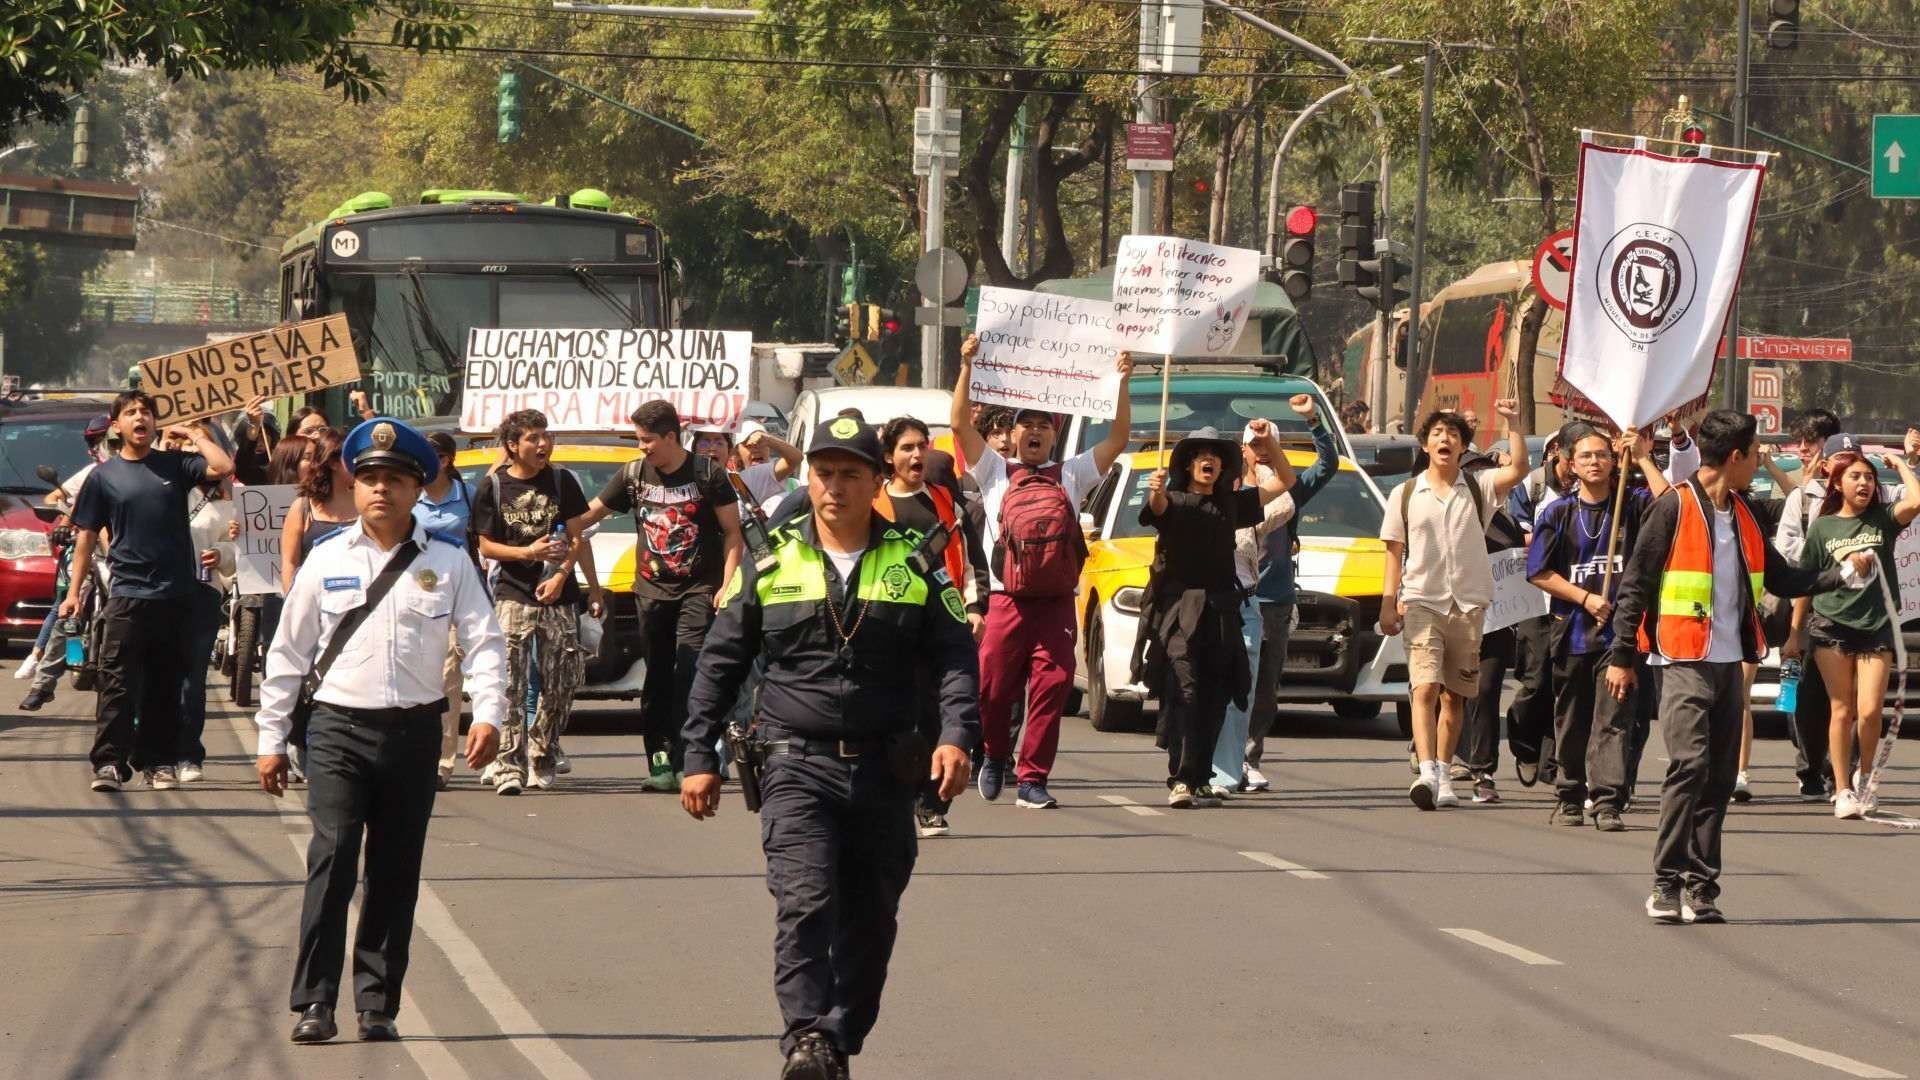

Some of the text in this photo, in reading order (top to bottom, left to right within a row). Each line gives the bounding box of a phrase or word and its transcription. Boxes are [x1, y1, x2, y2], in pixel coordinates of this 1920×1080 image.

[335, 238, 357, 250] M1
[1126, 240, 1148, 264] Soy
[1131, 263, 1153, 278] sin
[1159, 261, 1191, 280] tener
[1194, 272, 1233, 287] apoyo
[981, 290, 1018, 321] Soy
[143, 322, 341, 389] V6 NO SE VA A
[469, 328, 727, 361] LUCHAMOS POR UNA
[979, 329, 1034, 354] porque
[1087, 342, 1118, 359] mis
[1754, 342, 1847, 355] LINDAVISTA
[152, 355, 330, 421] DEJAR CAER
[466, 355, 740, 391] EDUCACIÓN DE CALIDAD.
[1037, 385, 1113, 412] derechos
